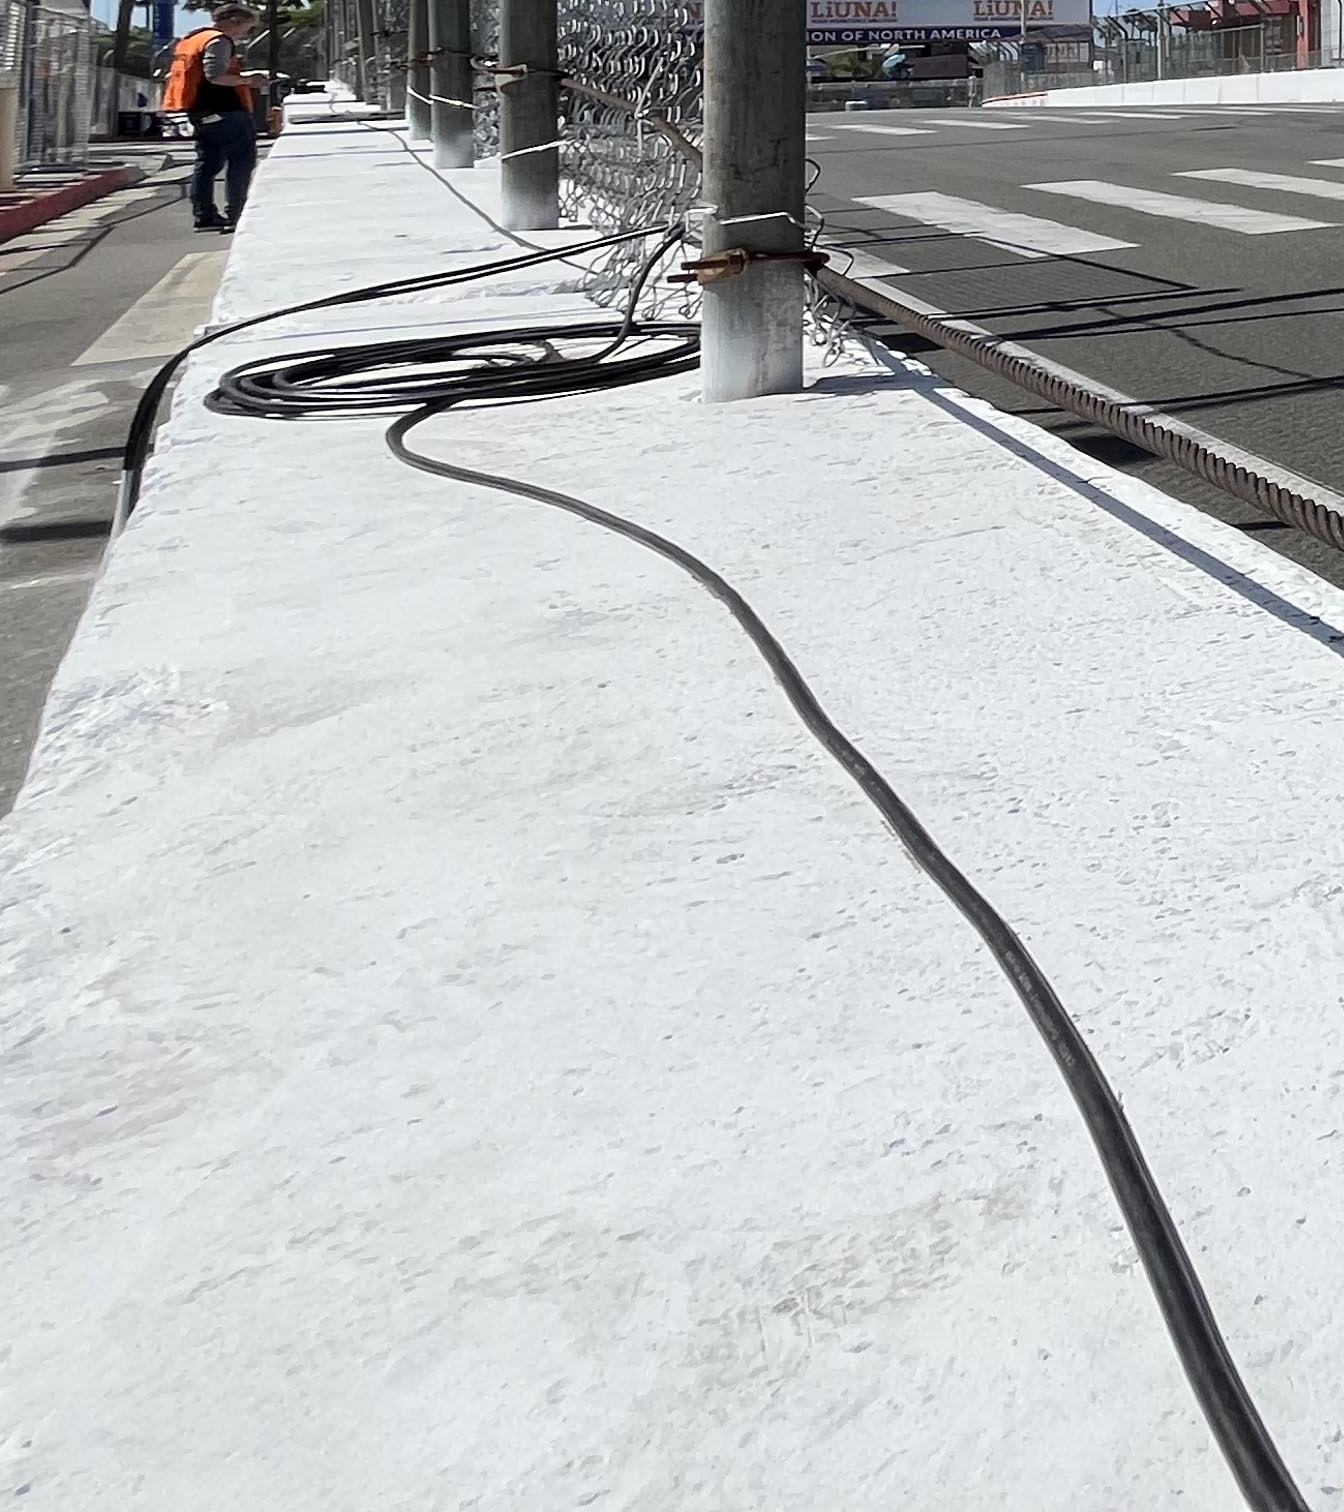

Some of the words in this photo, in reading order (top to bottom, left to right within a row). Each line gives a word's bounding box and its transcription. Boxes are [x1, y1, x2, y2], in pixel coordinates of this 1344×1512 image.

[841, 31, 864, 41] OF
[869, 29, 926, 40] NORTH
[930, 28, 1002, 39] AMERICA
